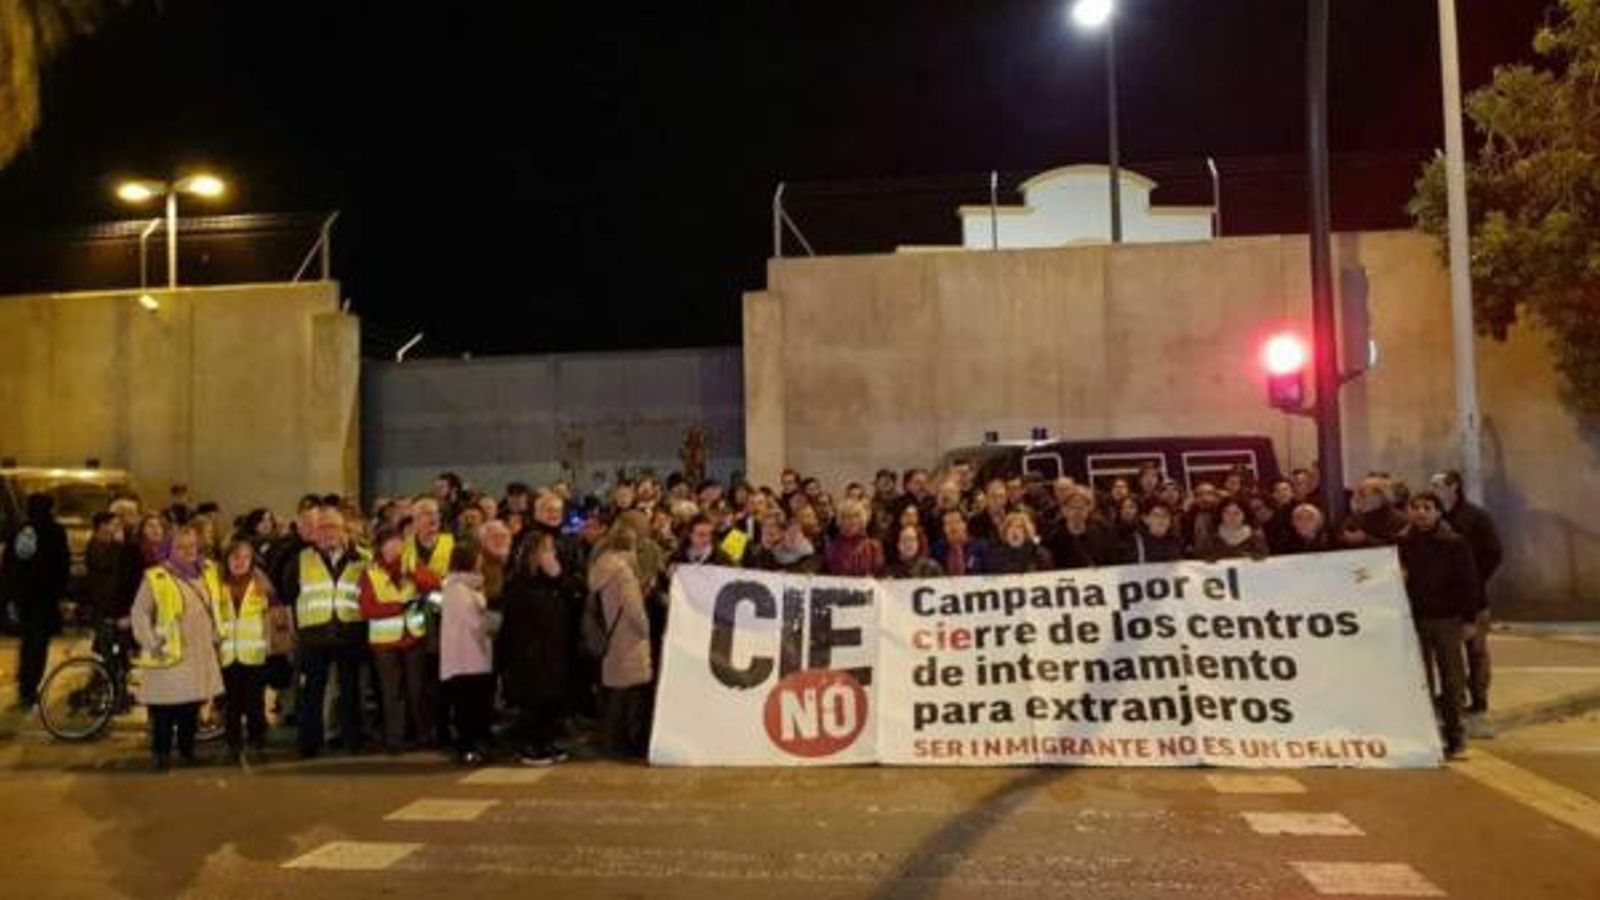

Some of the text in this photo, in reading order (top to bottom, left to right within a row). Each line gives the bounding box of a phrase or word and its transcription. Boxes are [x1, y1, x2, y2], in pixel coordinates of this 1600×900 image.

[911, 567, 1239, 617] Campaña por el
[708, 580, 874, 691] CIE
[913, 609, 1360, 650] cierre de los centros
[912, 645, 1298, 686] de internamiento
[913, 685, 1294, 731] para extranjeros
[913, 735, 1387, 759] SER INMIGRANTE NO ES UN DELITO
